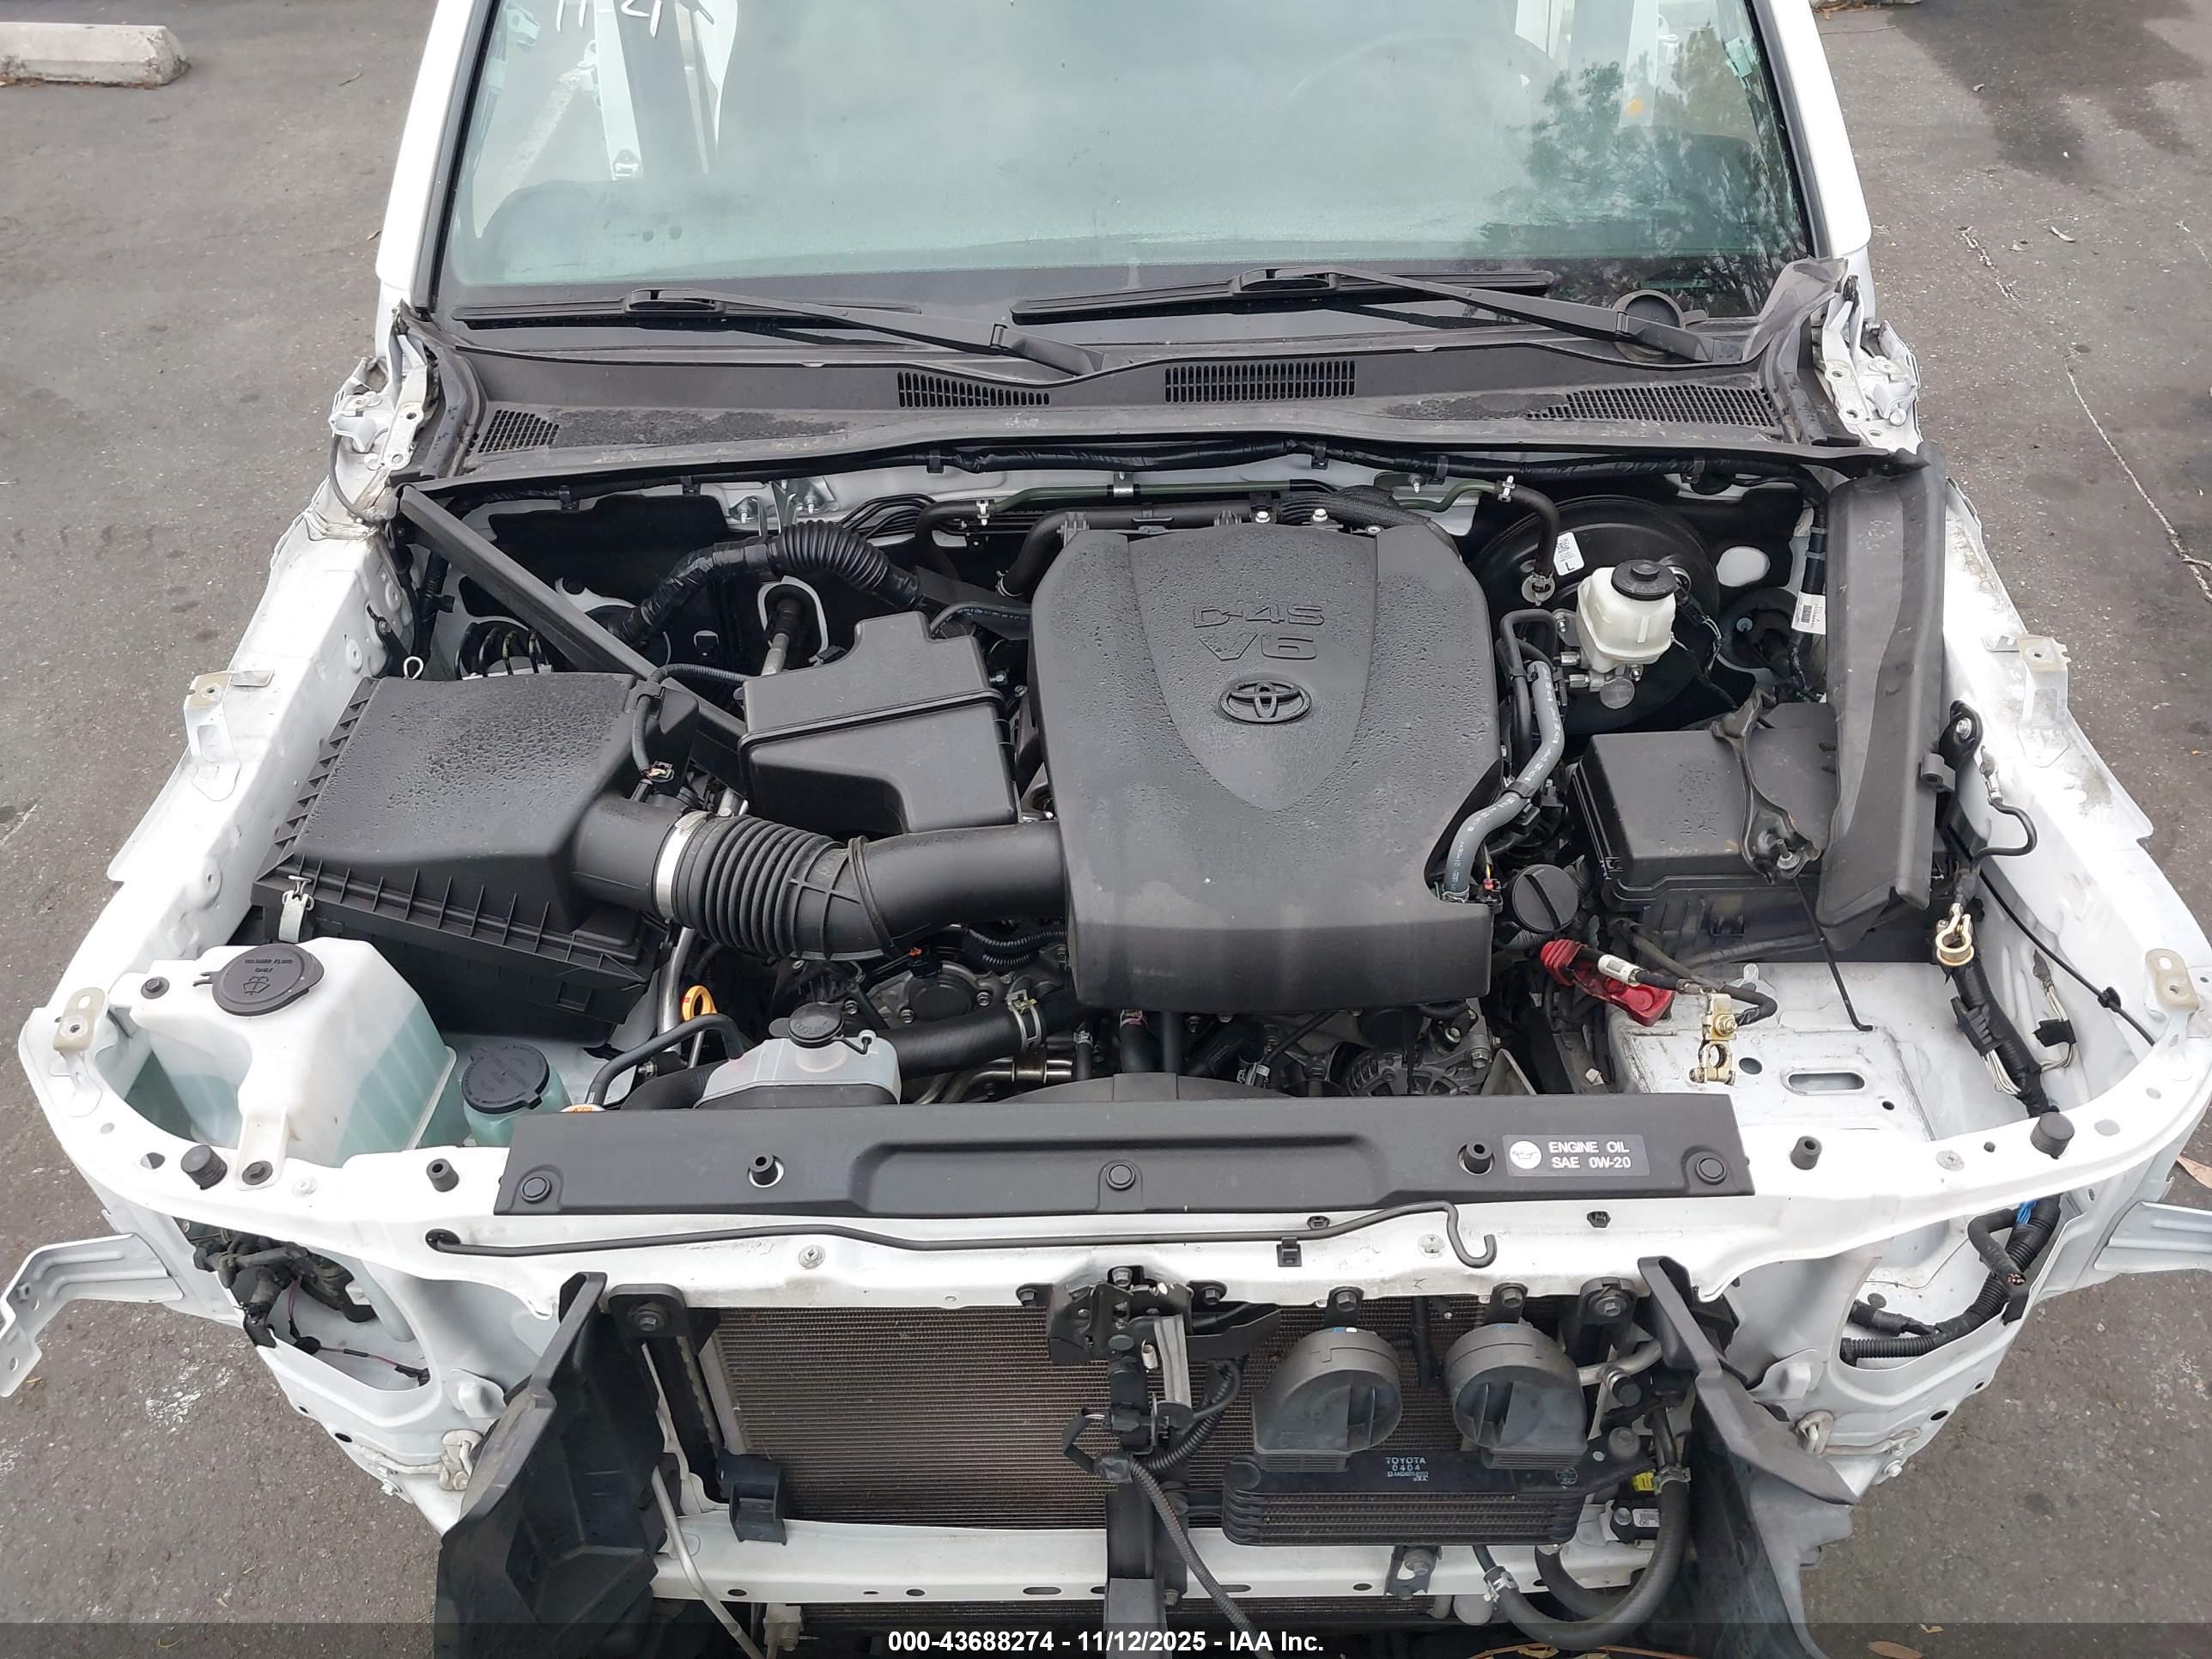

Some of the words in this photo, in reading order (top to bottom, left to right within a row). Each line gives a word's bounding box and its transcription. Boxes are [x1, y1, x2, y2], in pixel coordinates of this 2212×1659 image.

[1565, 562, 1575, 571] L
[1198, 631, 1317, 660] V6
[1548, 1140, 1599, 1153] ENGINE
[1607, 1140, 1630, 1154] OIL
[1551, 1156, 1580, 1169] SAE
[1589, 1156, 1632, 1169] 0W-20
